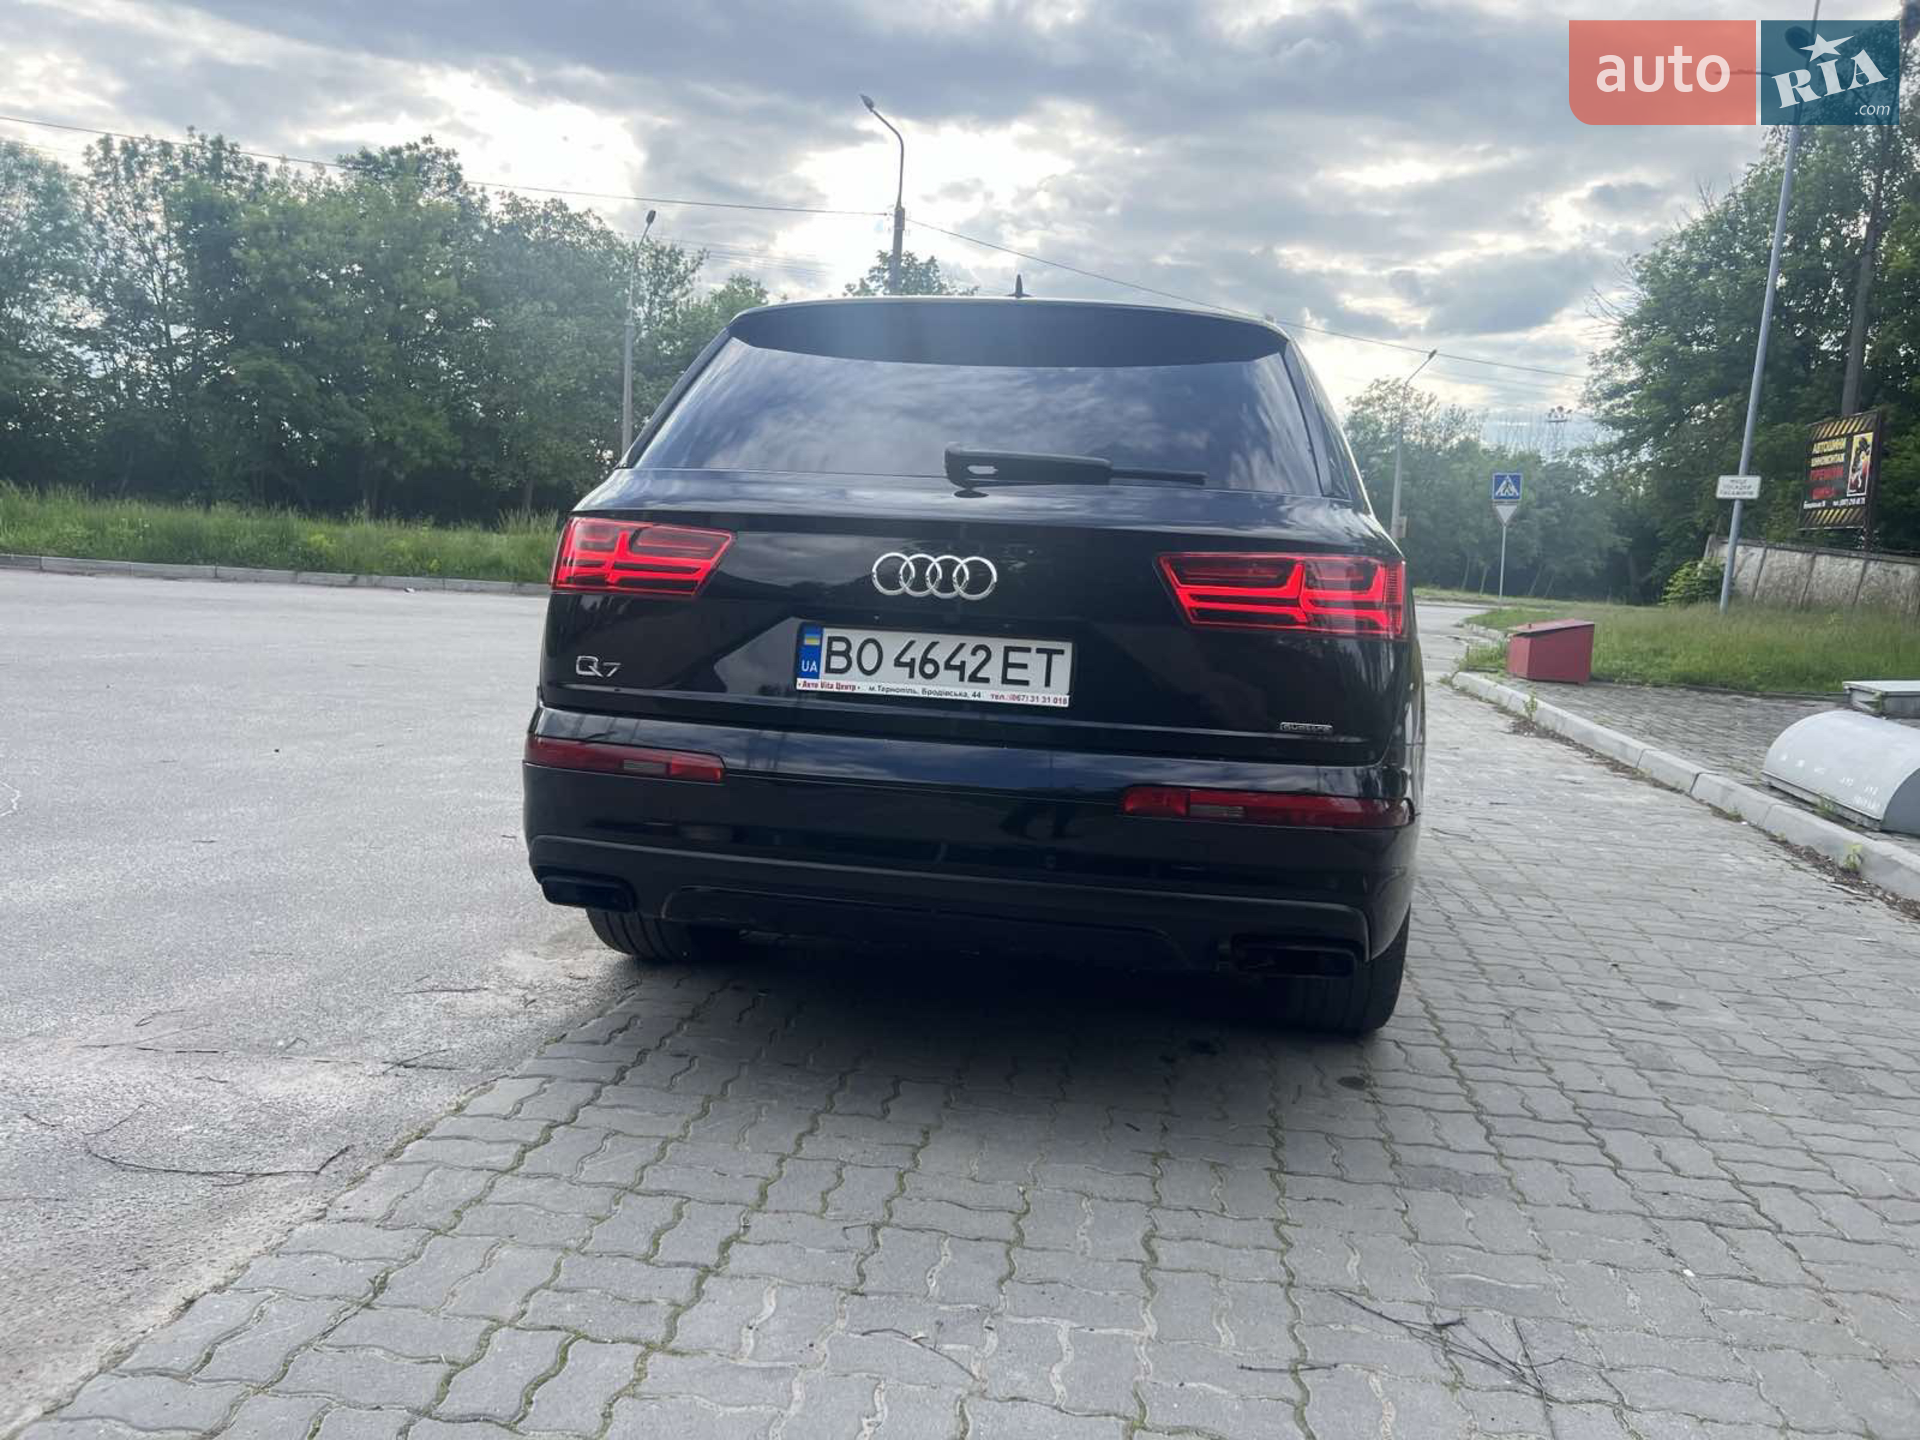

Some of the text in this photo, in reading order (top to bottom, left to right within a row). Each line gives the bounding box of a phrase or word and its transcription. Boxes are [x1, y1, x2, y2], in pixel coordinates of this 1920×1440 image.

[576, 655, 621, 678] Q7
[801, 660, 819, 673] UA
[824, 636, 1065, 688] BO 4642 ET
[820, 681, 834, 690] Vita
